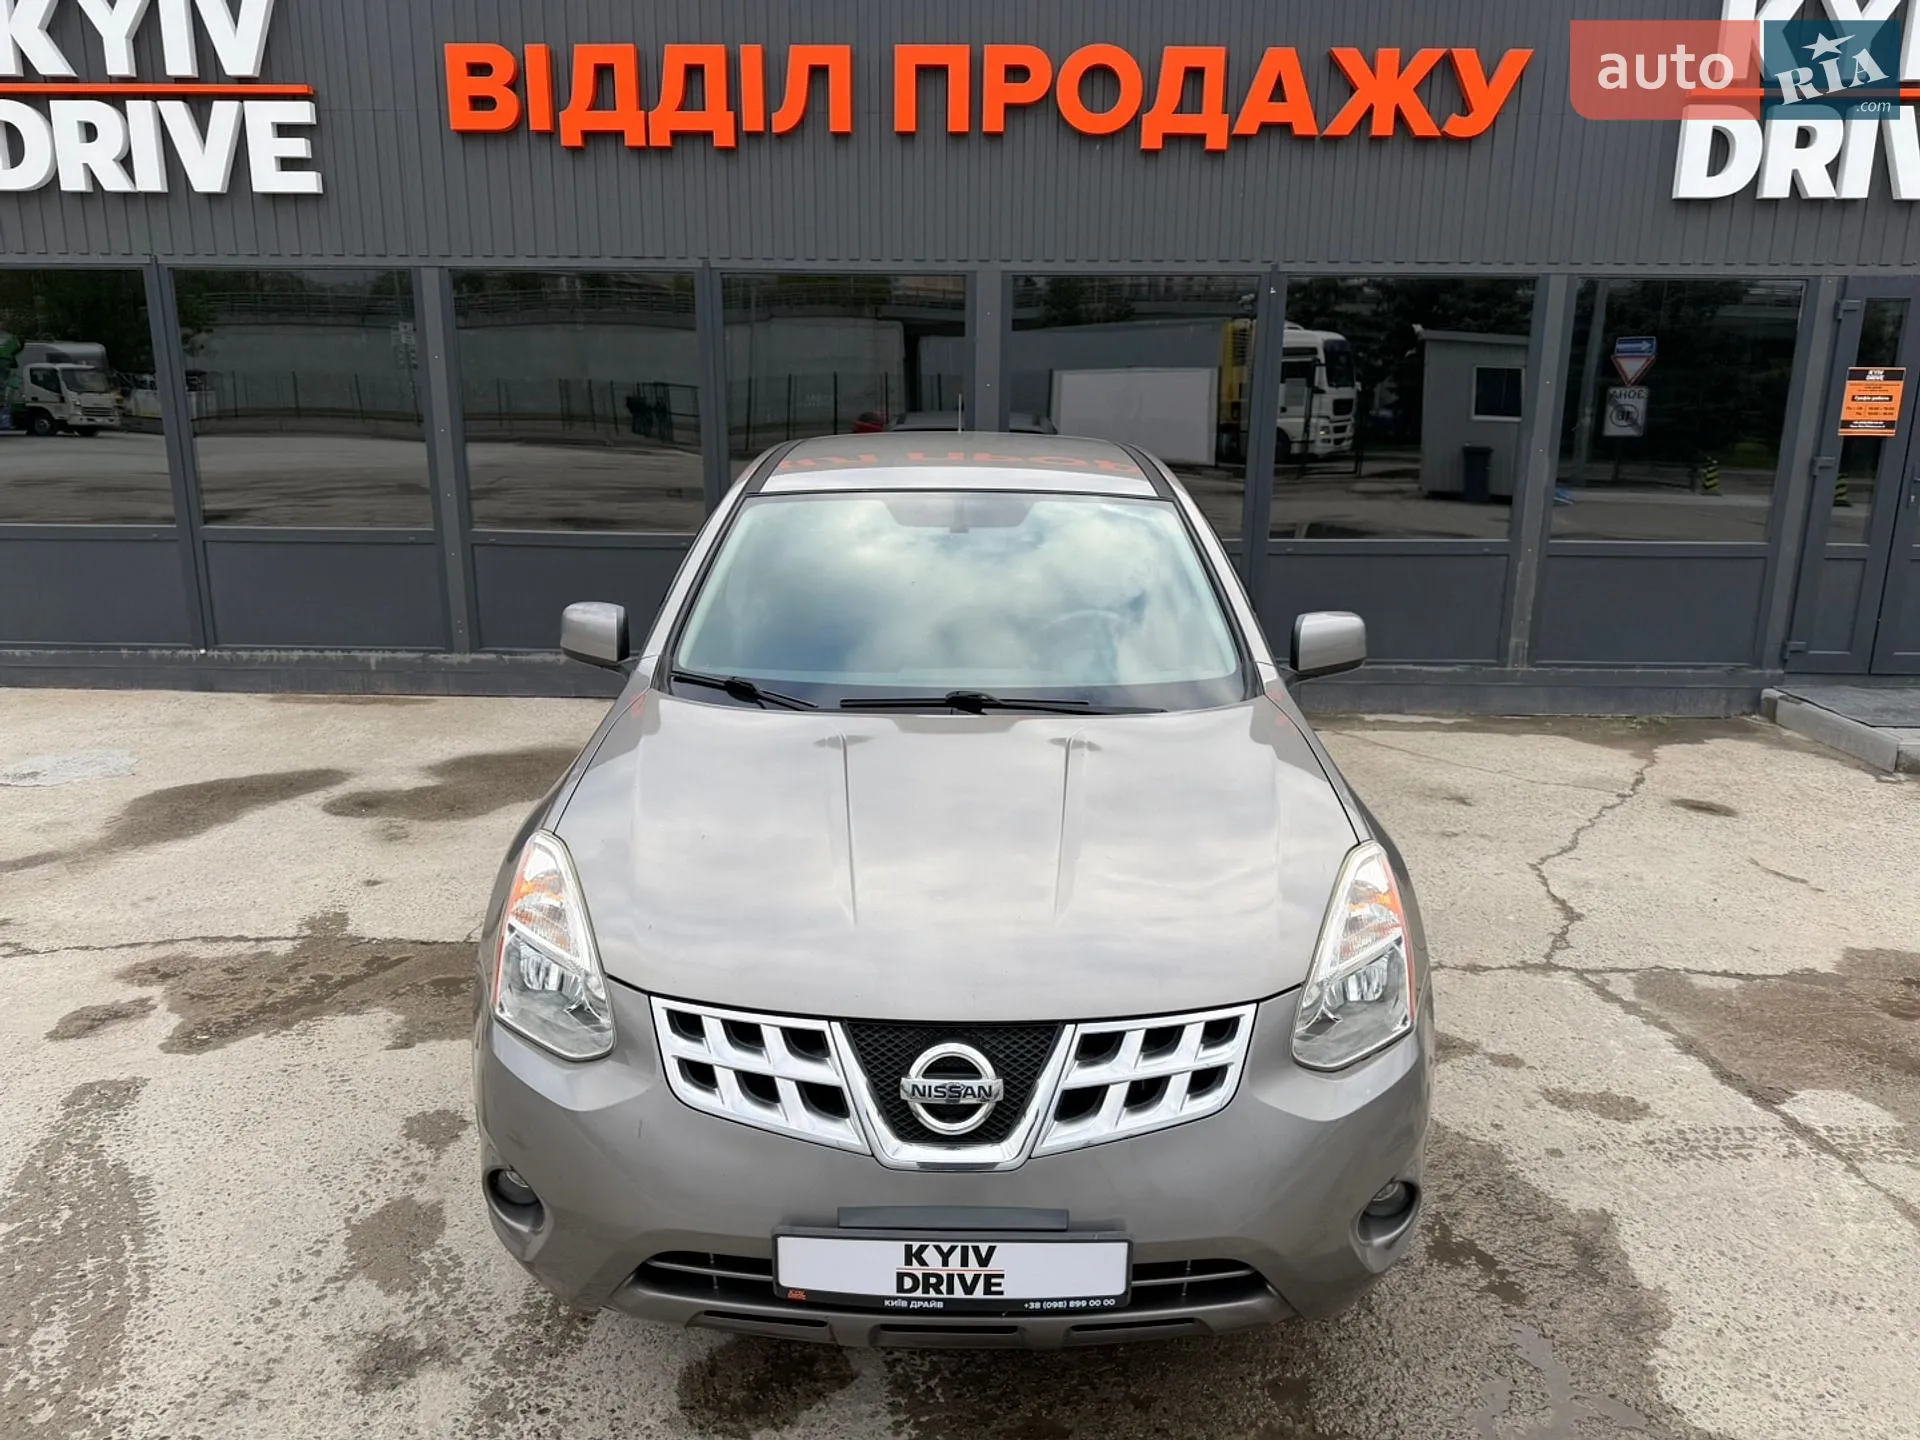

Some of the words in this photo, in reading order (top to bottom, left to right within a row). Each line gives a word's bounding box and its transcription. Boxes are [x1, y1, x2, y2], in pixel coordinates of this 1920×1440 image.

[0, 0, 274, 78] KYIV
[444, 42, 852, 149] ВІДДІЛ
[893, 43, 1534, 152] ПРОДАЖУ
[0, 99, 323, 194] DRIVE
[911, 1083, 992, 1099] NISSAN
[904, 1244, 997, 1268] KYIV
[896, 1272, 1004, 1296] DRIVE
[884, 1298, 908, 1308] КИЇВ
[909, 1300, 944, 1309] ДРАЙВ
[1088, 1299, 1101, 1307] 00
[1103, 1298, 1116, 1306] 00
